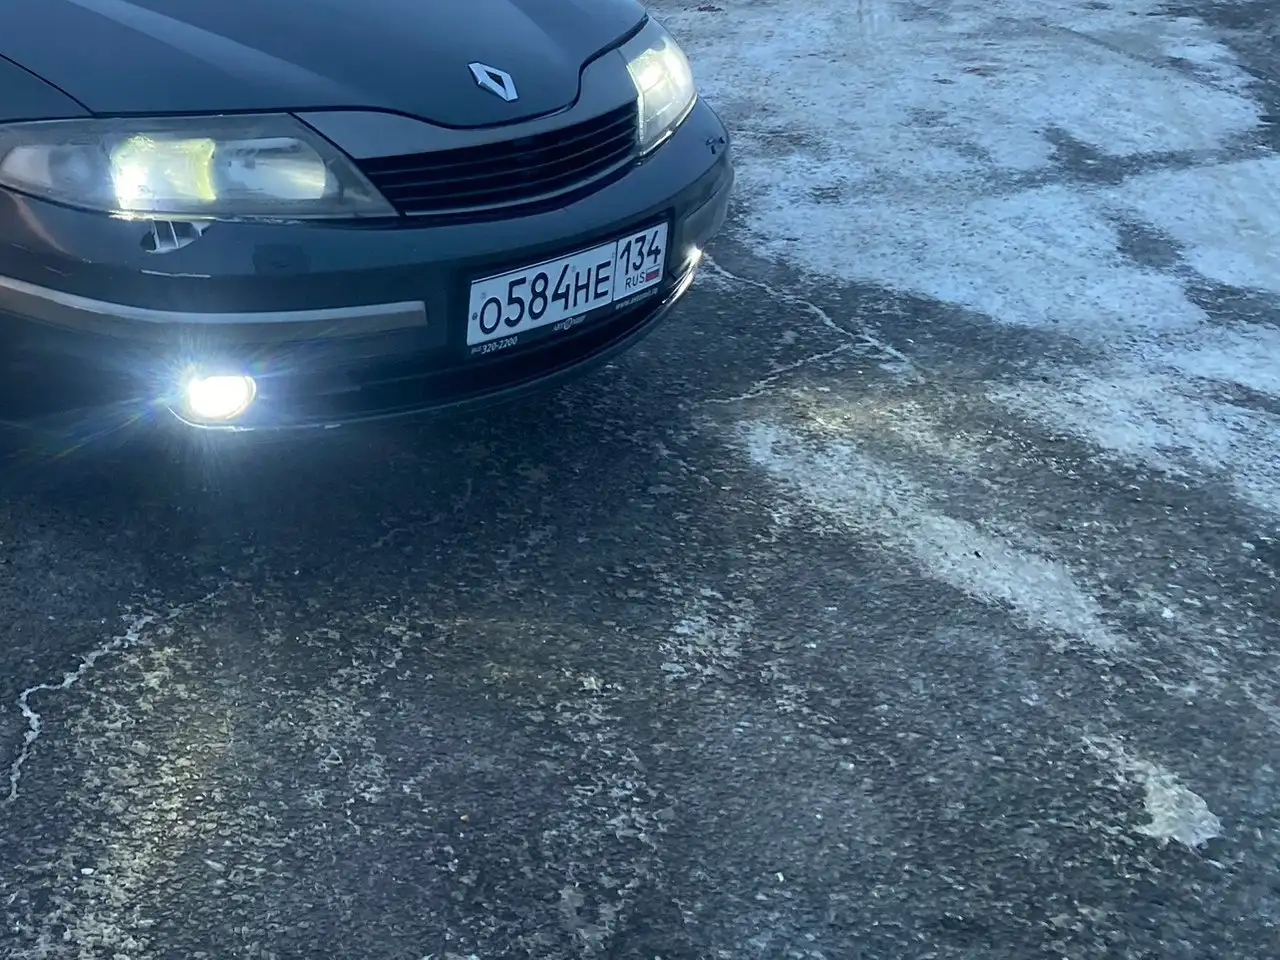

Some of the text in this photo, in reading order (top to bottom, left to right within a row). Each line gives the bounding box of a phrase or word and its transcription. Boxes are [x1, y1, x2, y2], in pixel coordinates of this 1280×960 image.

[478, 230, 662, 334] О584НЕ 134
[624, 267, 645, 289] RUS
